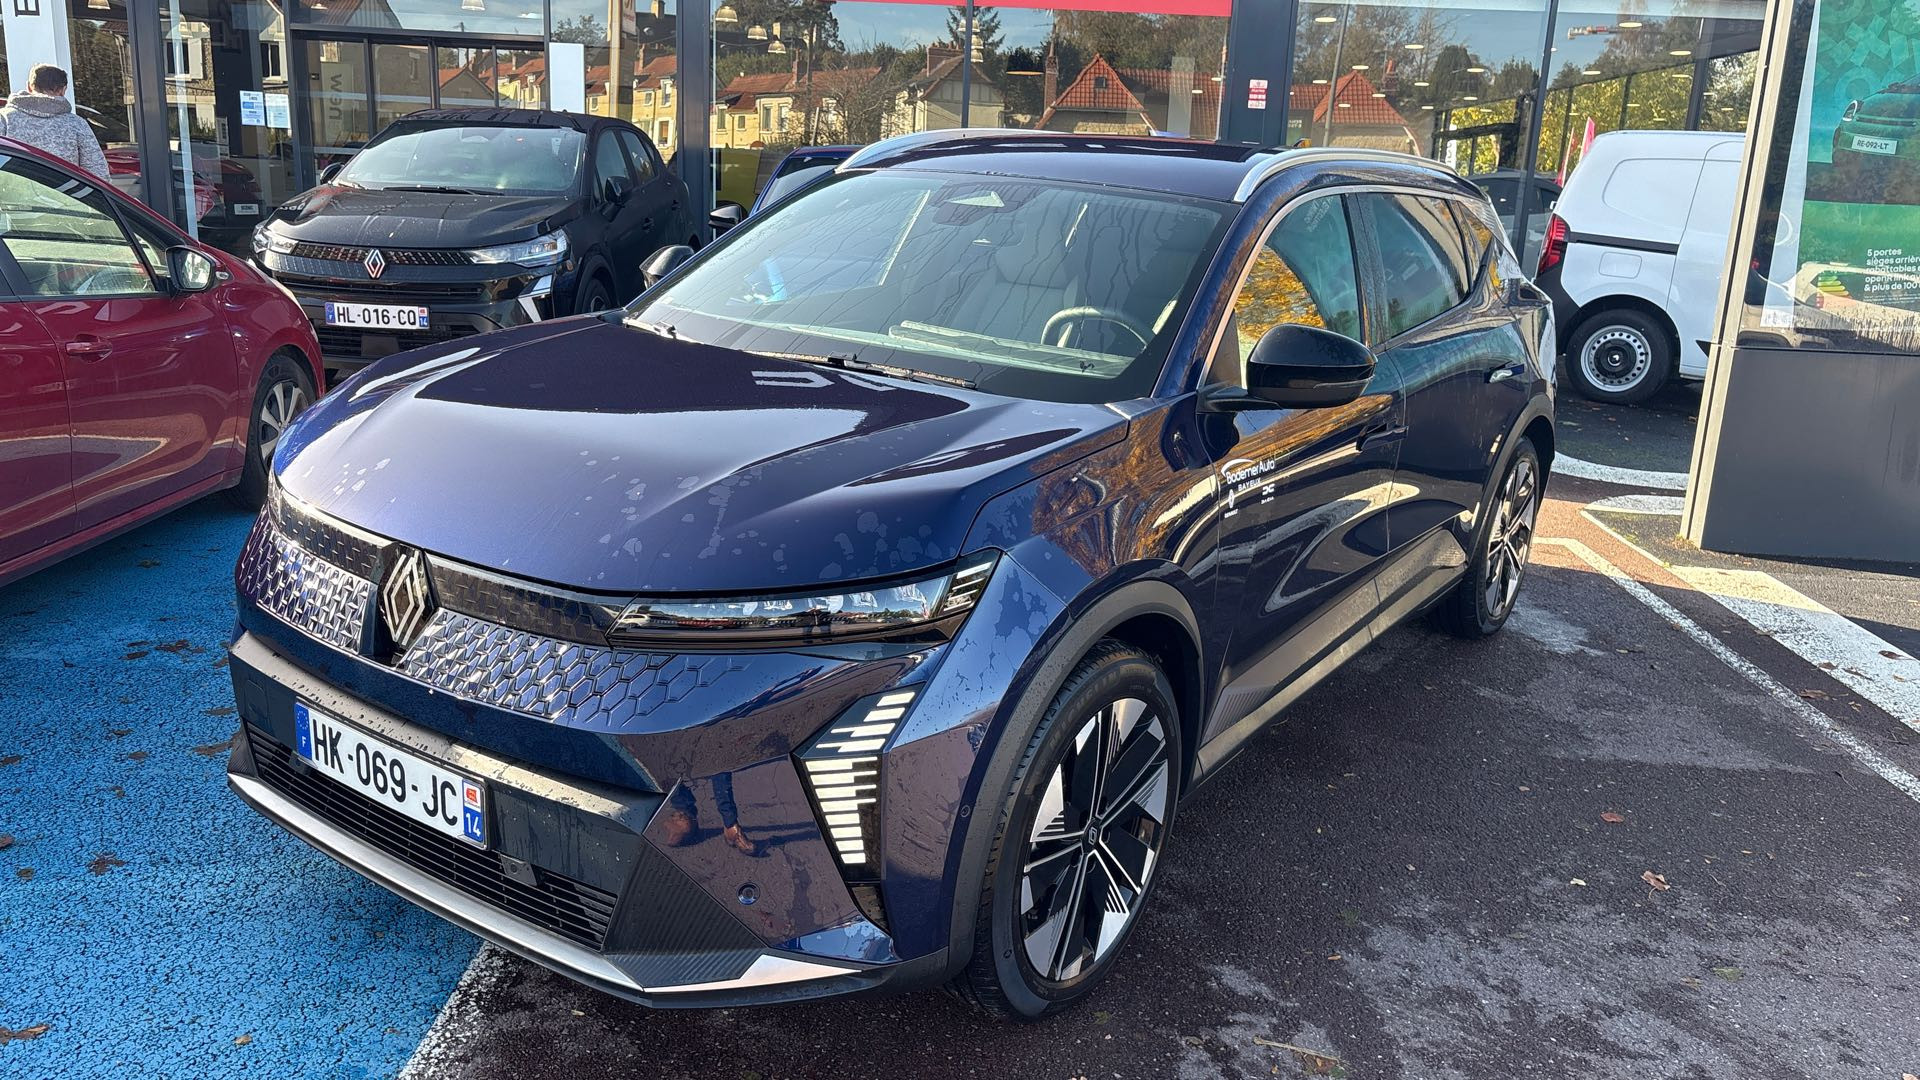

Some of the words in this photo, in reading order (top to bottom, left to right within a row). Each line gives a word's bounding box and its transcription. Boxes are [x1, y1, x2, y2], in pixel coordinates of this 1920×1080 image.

[1867, 248, 1873, 257] 5
[1873, 248, 1902, 258] portes
[1866, 257, 1894, 267] sièges
[1895, 255, 1920, 264] arrièr
[1866, 264, 1917, 274] rabattables
[1864, 283, 1871, 292] &
[1872, 283, 1890, 293] plus
[1891, 281, 1902, 290] de
[1903, 281, 1918, 290] 100
[336, 306, 417, 326] HL-016-CQ
[419, 317, 428, 327] 14
[301, 736, 307, 748] F
[312, 719, 458, 827] HK-069-JC
[465, 812, 481, 837] 14
